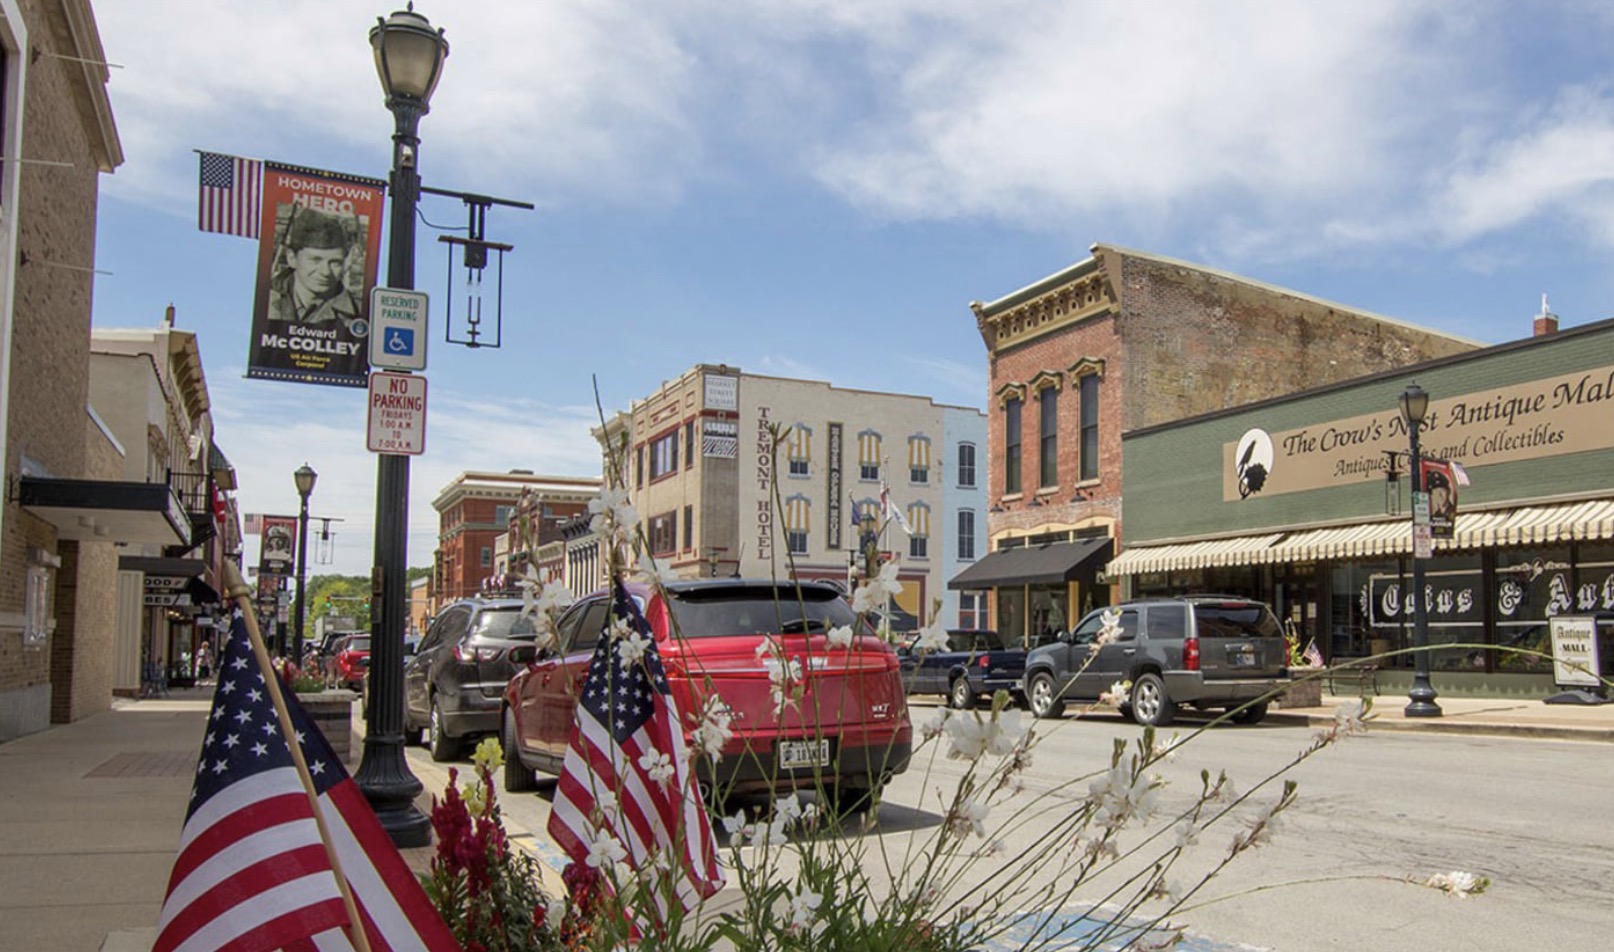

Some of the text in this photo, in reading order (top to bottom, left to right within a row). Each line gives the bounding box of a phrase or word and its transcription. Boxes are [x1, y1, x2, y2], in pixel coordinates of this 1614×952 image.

[278, 177, 371, 201] HOMETOWN
[292, 192, 355, 217] HERO
[381, 295, 419, 310] RESERVED
[381, 308, 417, 321] PARKING
[288, 325, 337, 339] Edward
[261, 334, 360, 355] McCOLLEY
[390, 379, 408, 394] NO
[374, 393, 422, 411] PARKING
[381, 409, 412, 419] FRIDAYS
[1283, 430, 1316, 456] The
[1320, 418, 1382, 452] Crow's
[1389, 411, 1439, 437] Nst
[1446, 394, 1545, 426] Antique
[392, 430, 401, 439] TO
[1440, 436, 1470, 460] and
[1473, 422, 1565, 457] Collectibles
[757, 407, 770, 560] TREMONT HOTEL
[1498, 581, 1524, 616] &
[1557, 625, 1591, 641] Antique
[1562, 643, 1587, 652] MALL
